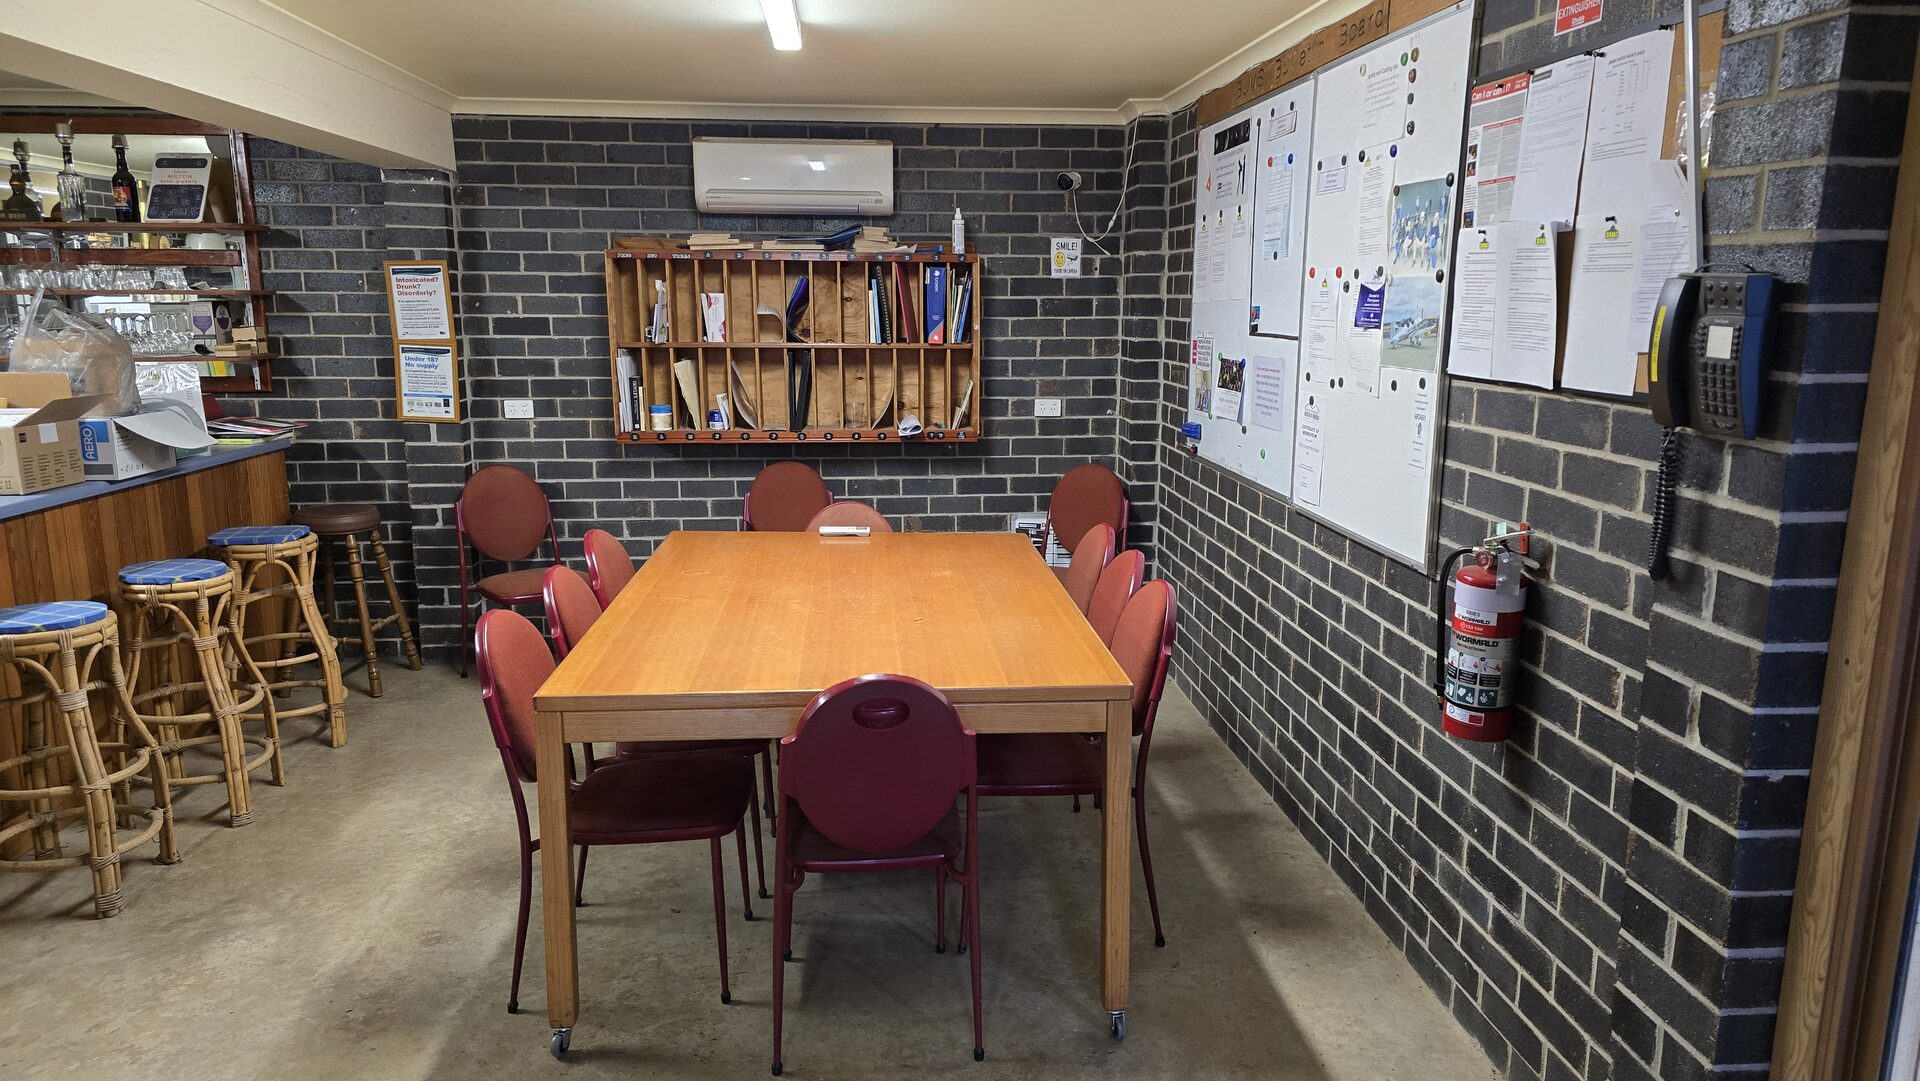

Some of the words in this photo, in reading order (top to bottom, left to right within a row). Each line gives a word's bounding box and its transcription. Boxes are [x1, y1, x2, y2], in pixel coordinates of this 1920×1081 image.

[1339, 4, 1385, 47] Board
[1056, 242, 1078, 250] SMILE!
[83, 428, 96, 460] AERO
[1462, 615, 1491, 624] WORMALD
[1456, 633, 1498, 647] WORMALD
[1457, 642, 1486, 652] INSTRUCTIONS
